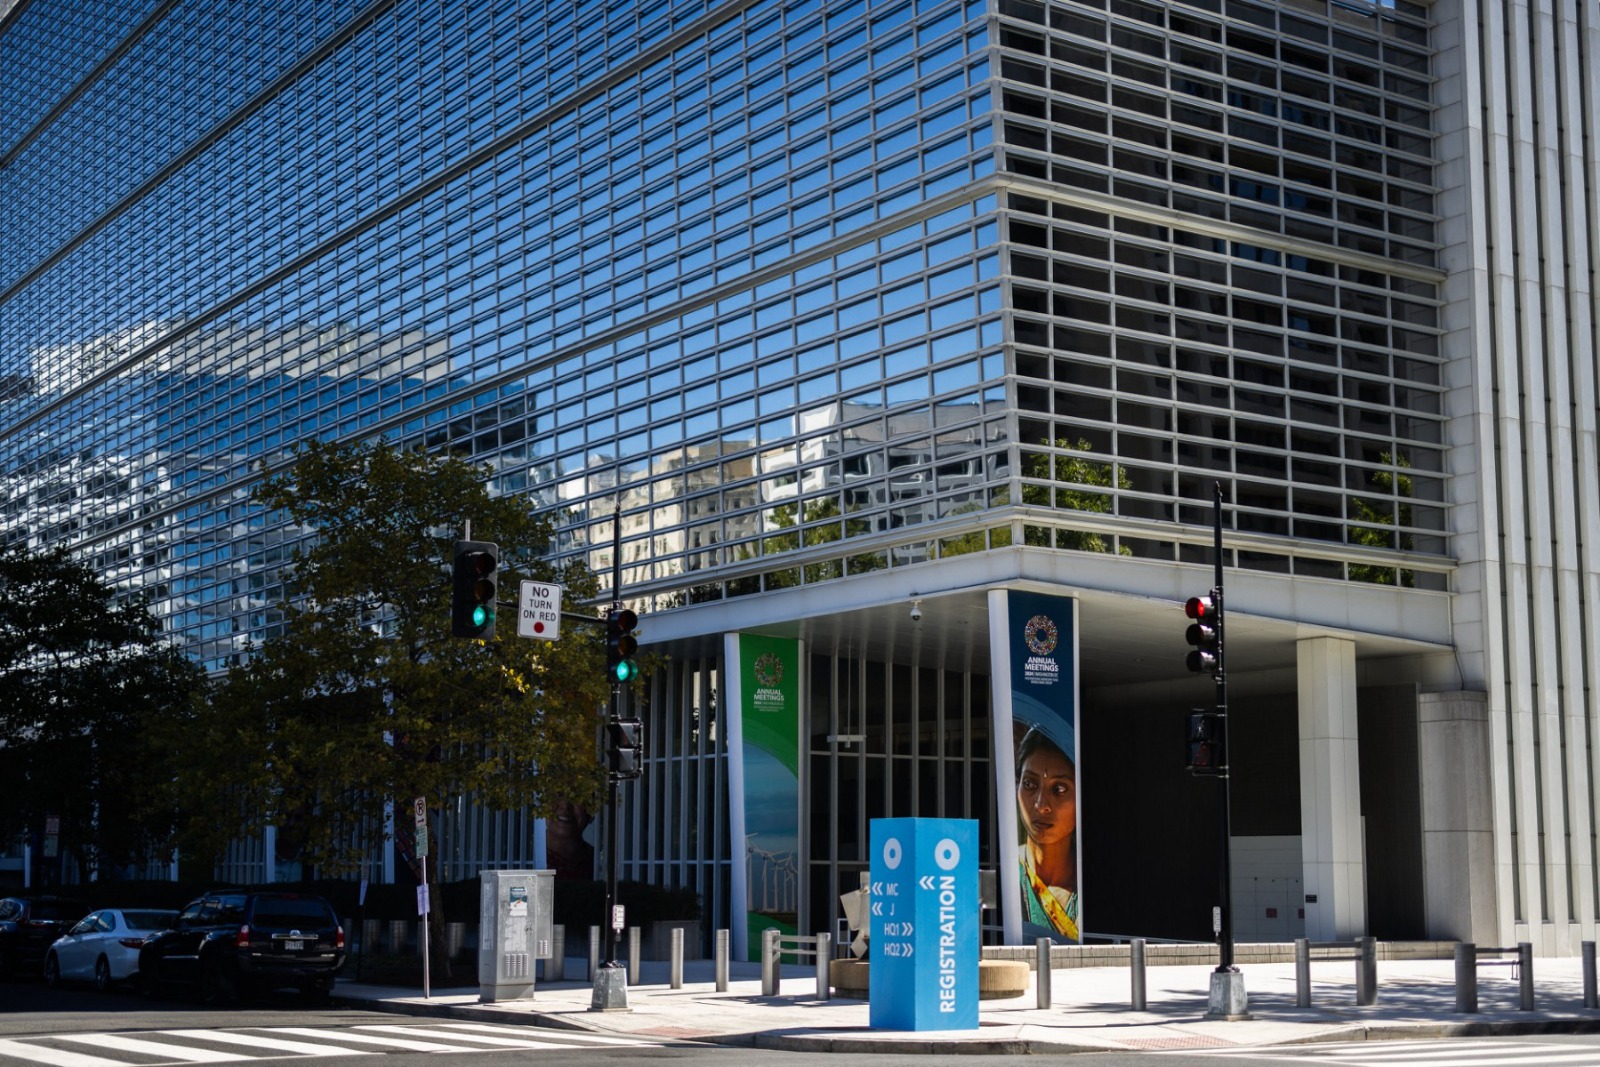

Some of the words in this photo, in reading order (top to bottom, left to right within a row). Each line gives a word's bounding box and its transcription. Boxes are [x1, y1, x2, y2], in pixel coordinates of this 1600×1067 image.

[532, 586, 549, 598] NO
[529, 599, 552, 610] TURN
[523, 610, 535, 619] ON
[539, 612, 556, 621] RED
[1027, 656, 1056, 665] ANNUAL
[1024, 663, 1059, 672] MEETINGS
[753, 694, 785, 702] MEETINGS
[886, 883, 899, 896] MC
[889, 903, 895, 916] J
[884, 923, 900, 937] HQ1
[884, 943, 900, 957] HQ2
[939, 876, 956, 1013] REGISTRATION
